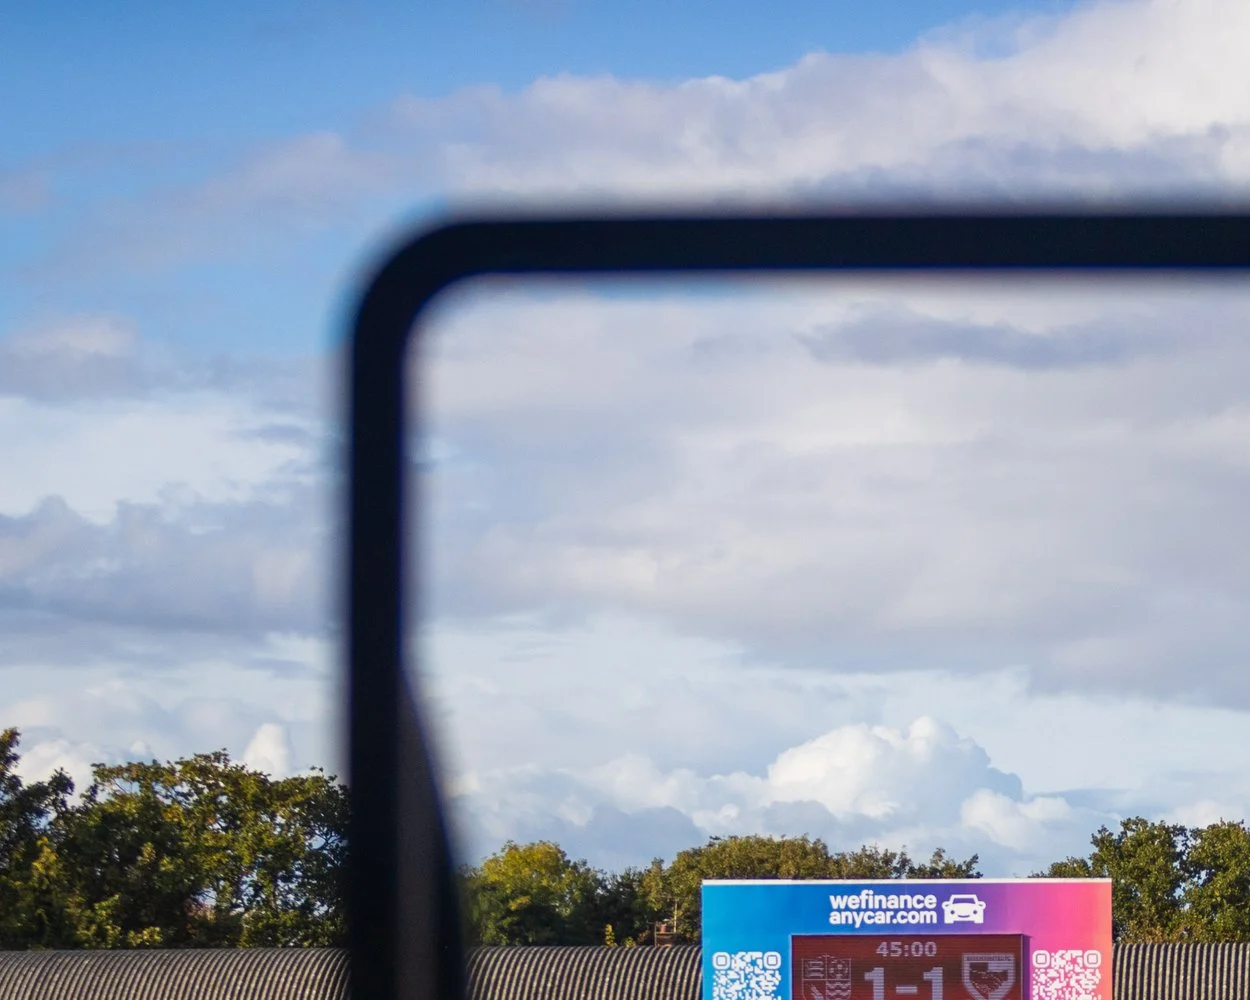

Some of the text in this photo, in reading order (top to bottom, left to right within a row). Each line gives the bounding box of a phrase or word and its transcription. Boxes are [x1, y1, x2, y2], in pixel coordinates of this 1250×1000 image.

[829, 889, 937, 909] wefinance
[829, 910, 937, 928] anycar.com
[876, 941, 937, 957] 45:00
